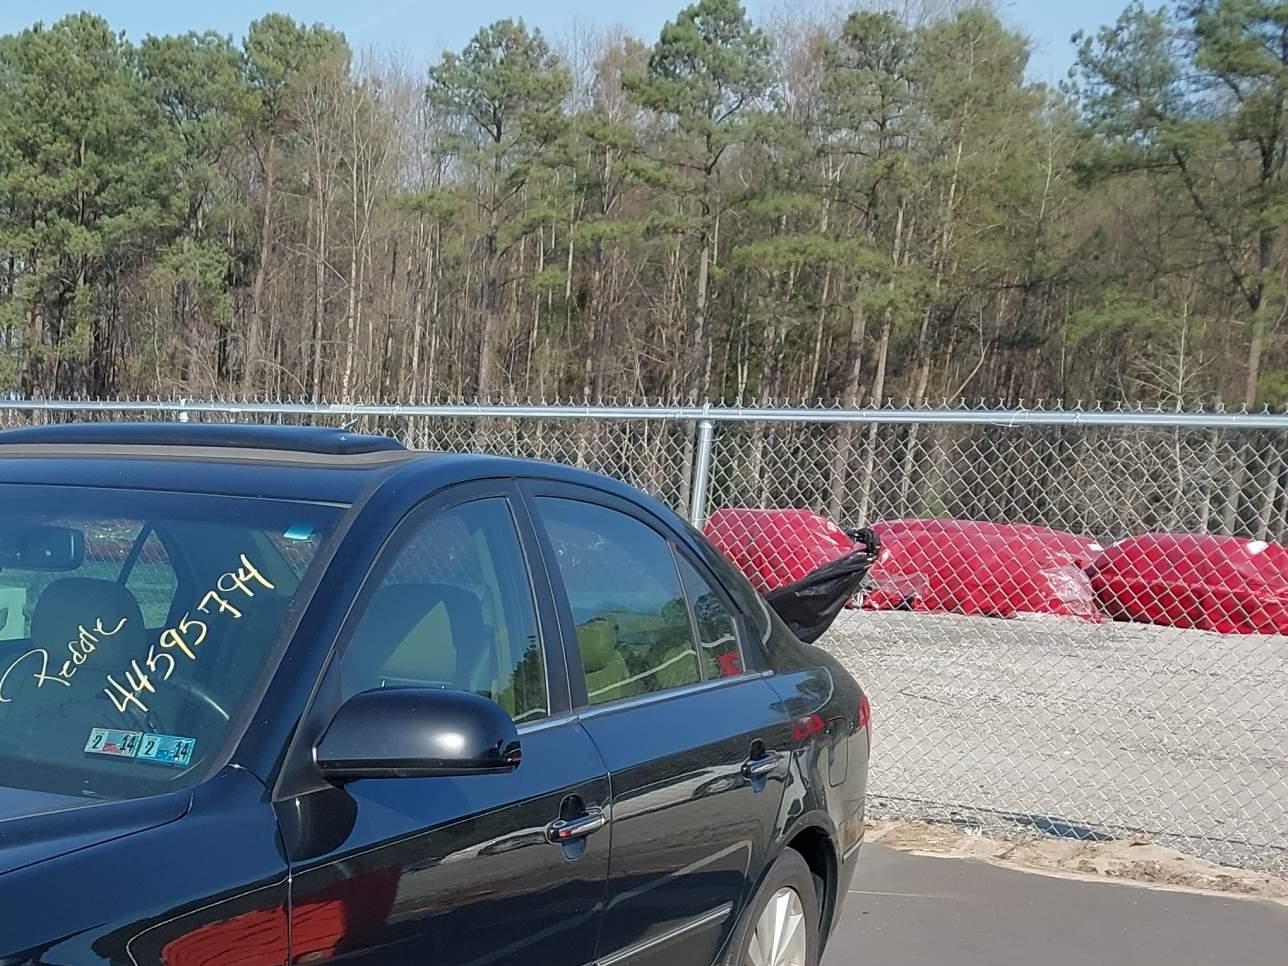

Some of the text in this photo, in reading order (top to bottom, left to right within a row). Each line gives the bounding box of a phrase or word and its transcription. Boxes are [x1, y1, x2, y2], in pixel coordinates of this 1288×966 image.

[104, 553, 275, 712] 44595794
[92, 734, 137, 751] 2 14
[144, 740, 190, 759] 2 14
